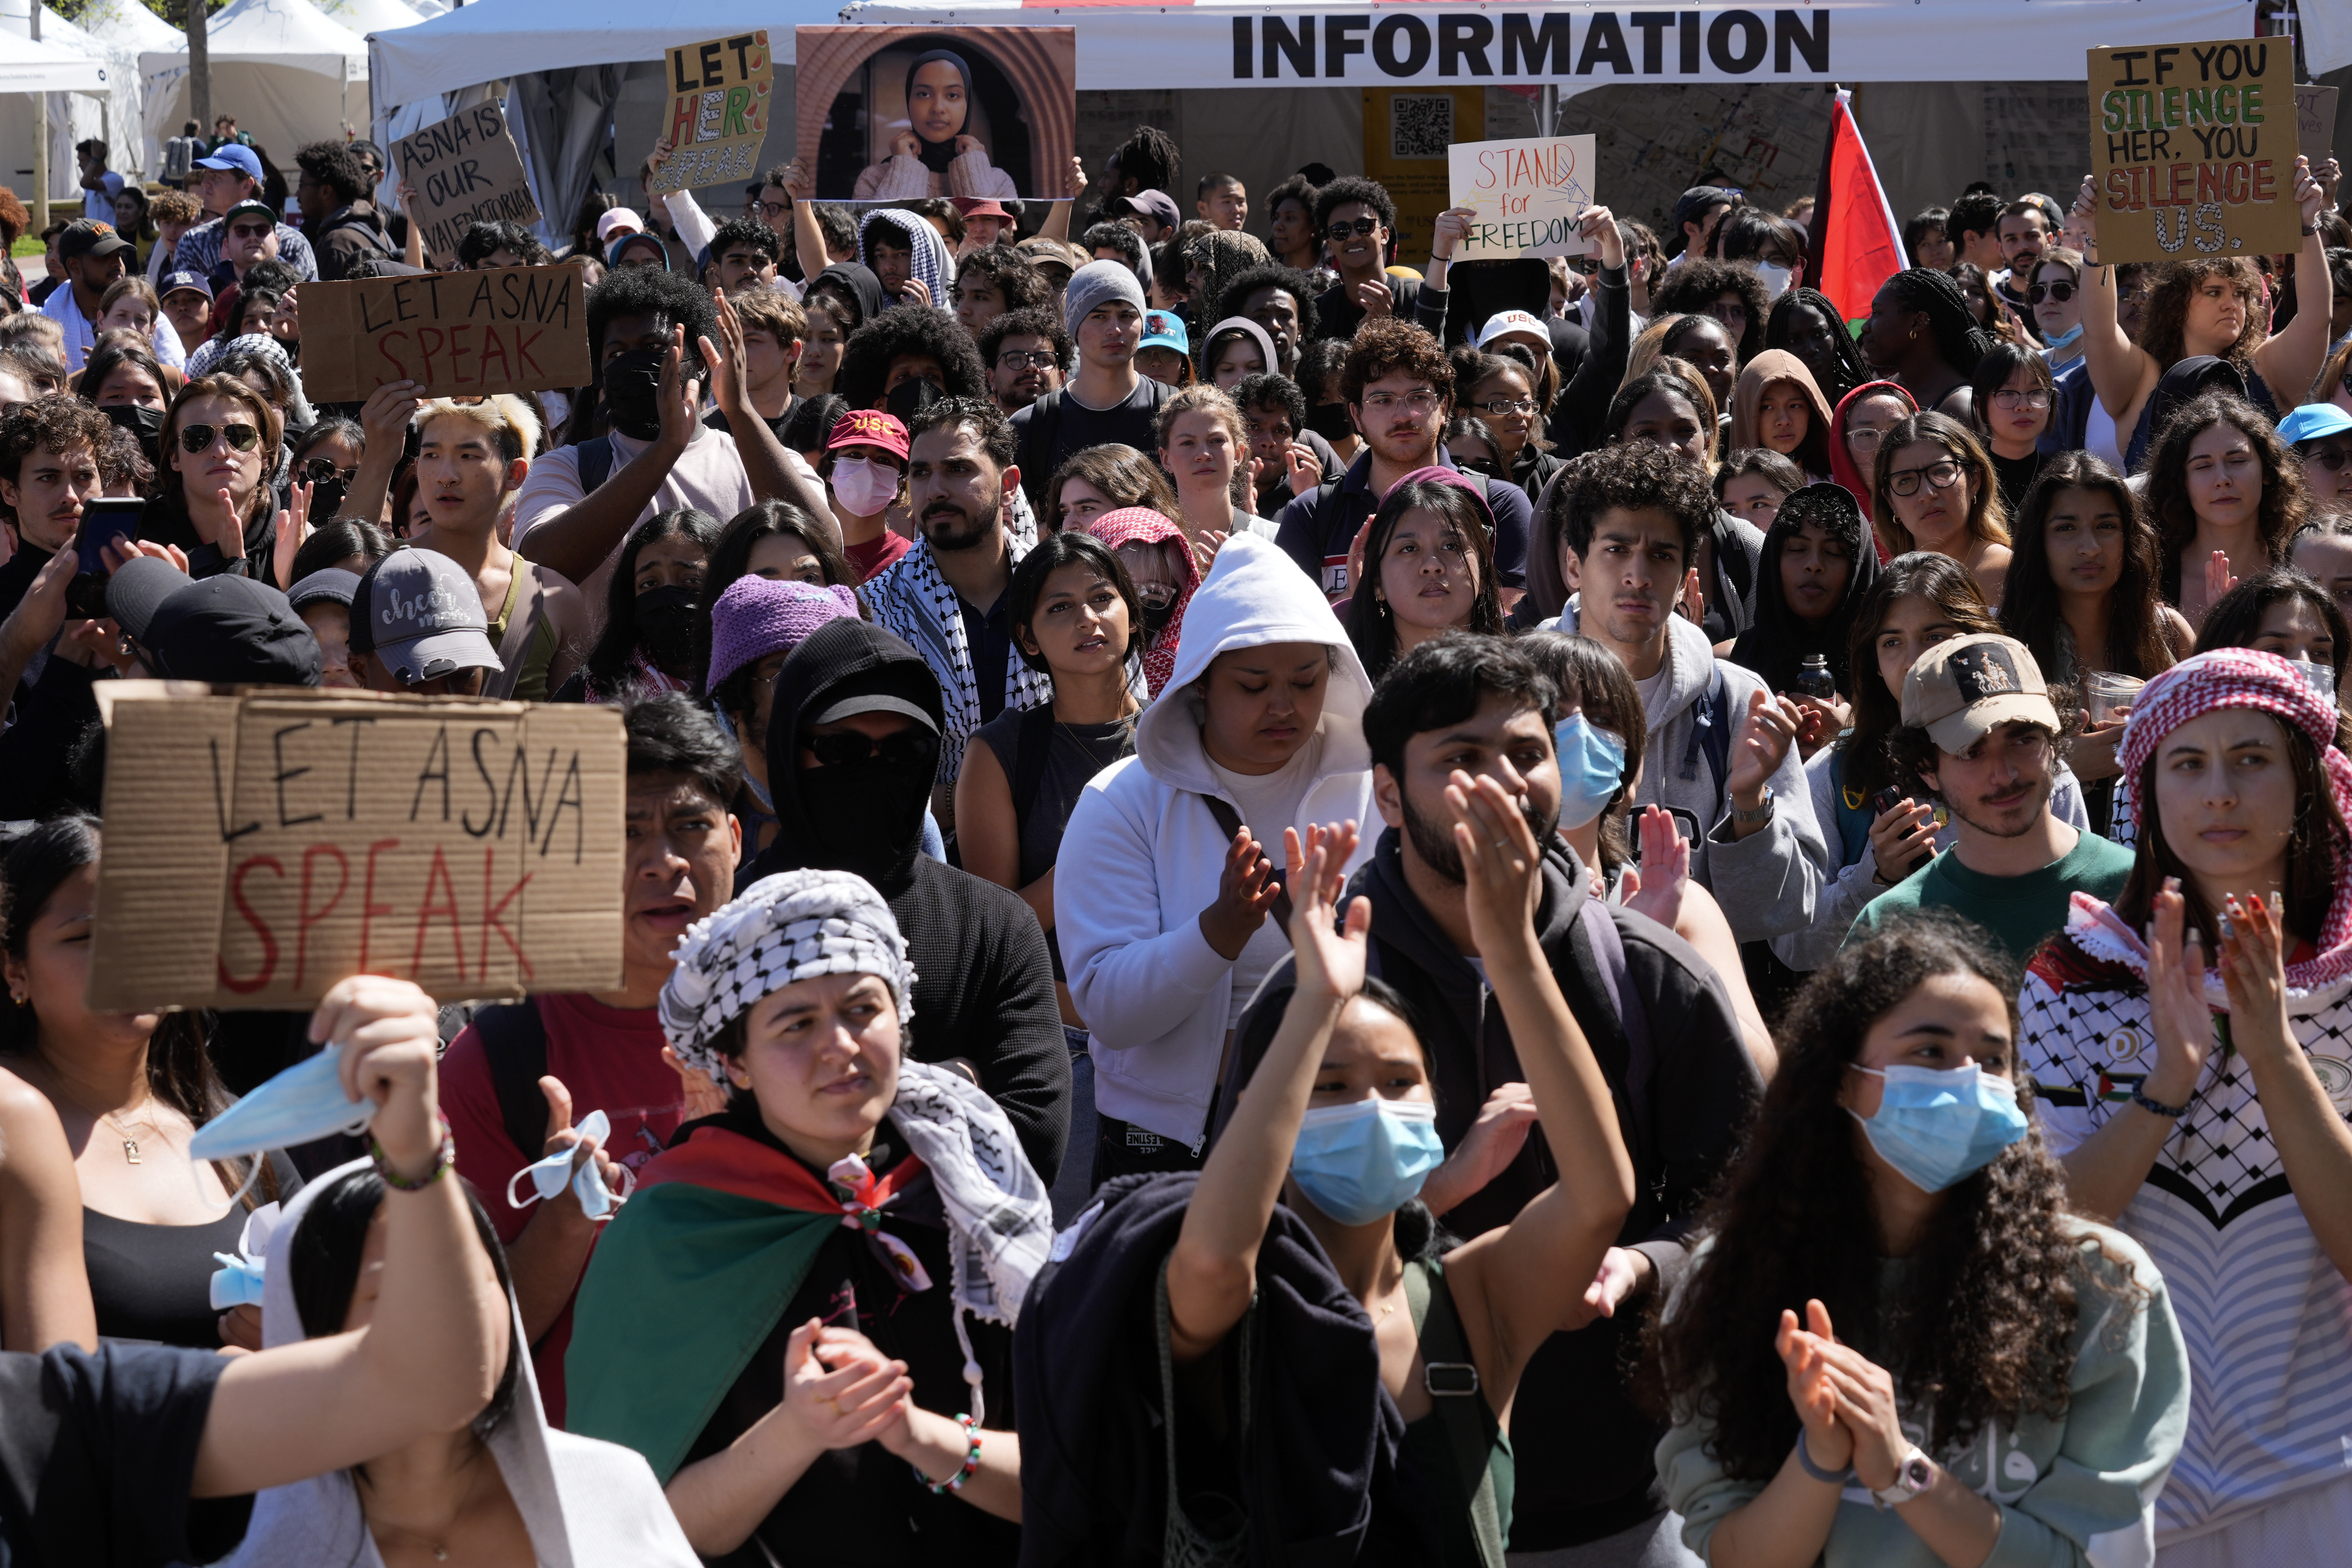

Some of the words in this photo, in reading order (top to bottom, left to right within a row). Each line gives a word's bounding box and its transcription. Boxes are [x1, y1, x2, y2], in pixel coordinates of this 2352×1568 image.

[674, 35, 753, 93] LET
[1232, 9, 1830, 78] INFORMATION
[2111, 47, 2180, 87] IF
[2191, 43, 2267, 81] YOU
[670, 87, 750, 147] HER
[2100, 84, 2265, 134] SILENCE
[402, 115, 471, 179] ASNA
[473, 107, 501, 141] IS
[653, 142, 756, 190] SPEAK
[1475, 143, 1575, 189] STAND
[2107, 129, 2181, 163] HER,
[2192, 126, 2258, 159] YOU
[426, 159, 493, 207] OUR
[1499, 193, 1531, 217] for
[2105, 160, 2277, 213] SILENCE
[91, 223, 114, 236] USC
[1463, 211, 1585, 251] FREEDOM
[2156, 203, 2242, 253] US.
[359, 275, 443, 333] LET
[468, 273, 571, 329] ASNA
[1507, 313, 1536, 326] USC
[375, 324, 546, 387] SPEAK
[855, 417, 894, 435] USC
[209, 717, 376, 842] LET
[410, 720, 584, 865] ASNA
[217, 837, 536, 994] SPEAK
[1128, 1134, 1162, 1144] LESTINE
